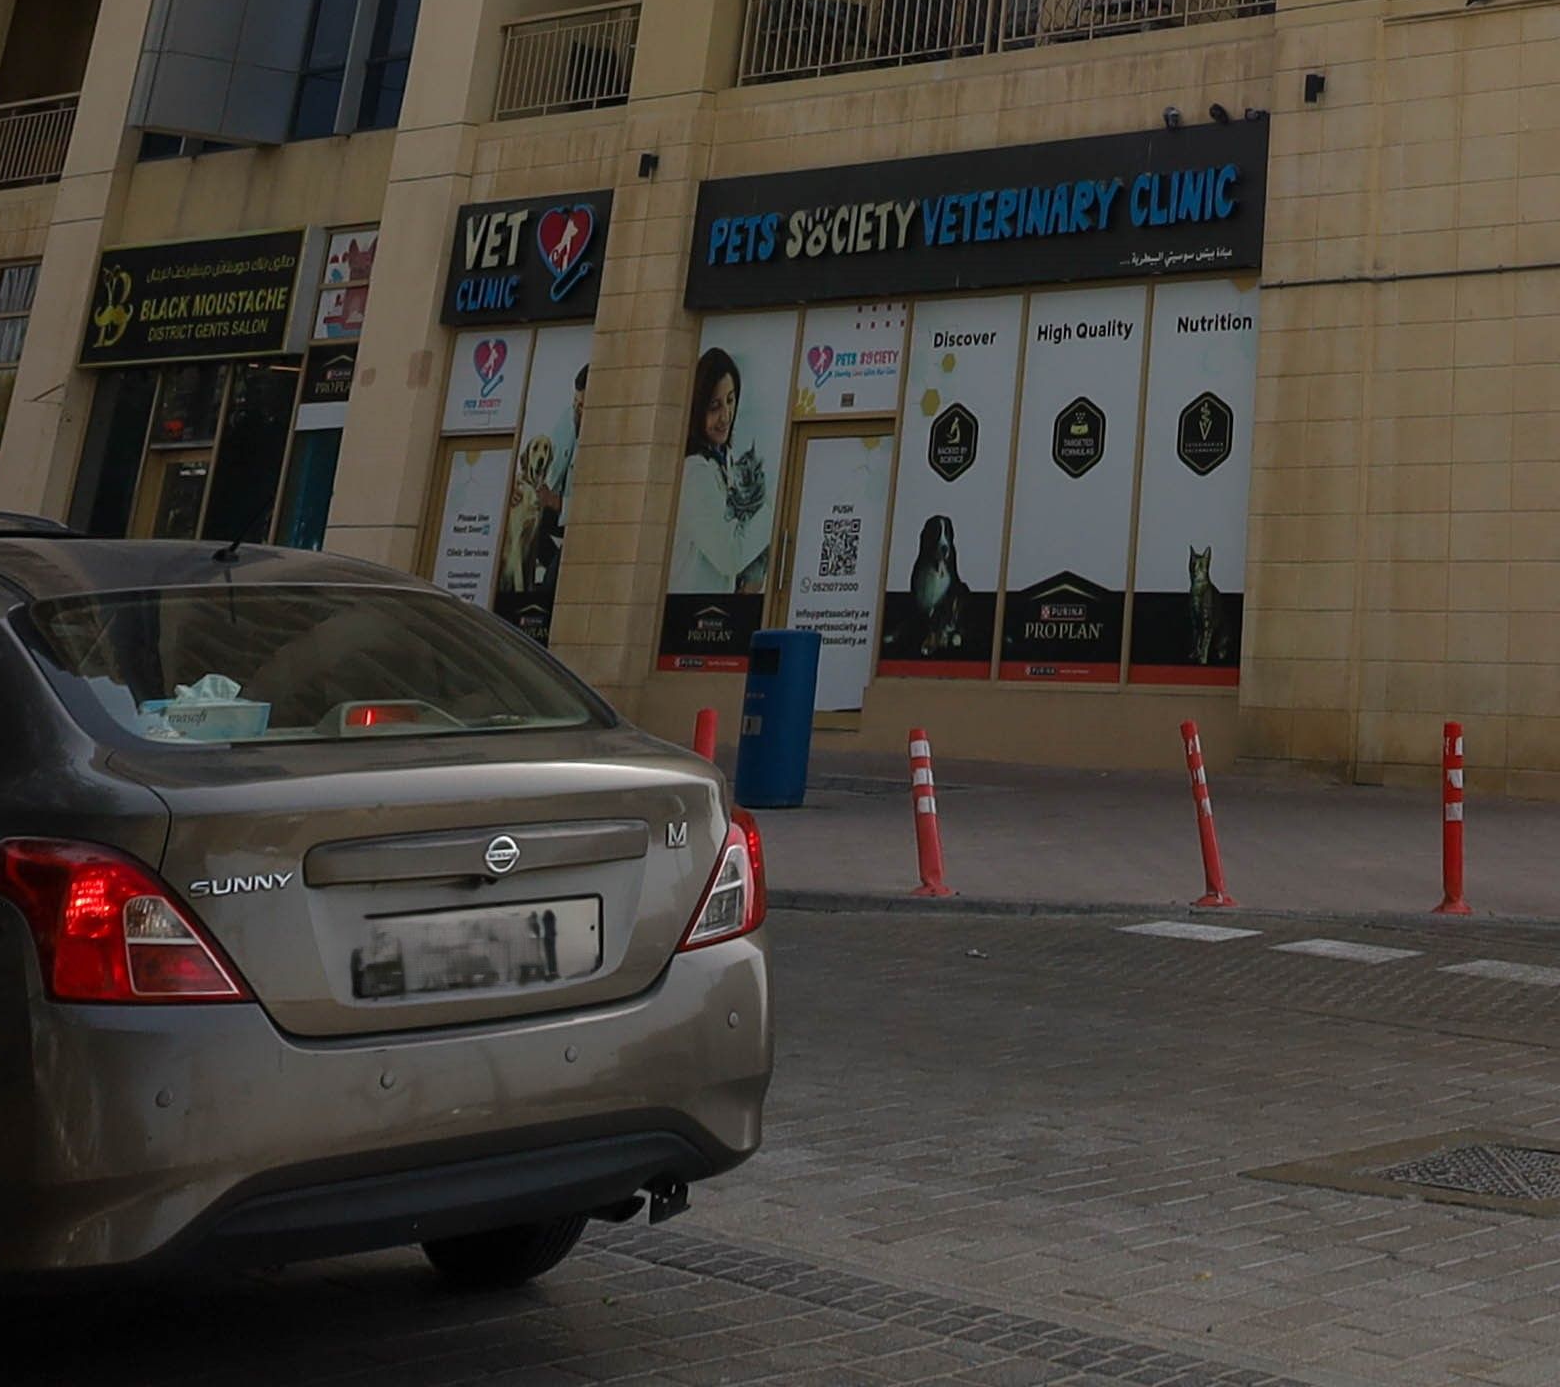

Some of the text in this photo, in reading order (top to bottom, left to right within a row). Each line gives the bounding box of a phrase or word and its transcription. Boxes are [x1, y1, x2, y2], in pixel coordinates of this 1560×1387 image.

[705, 163, 1239, 267] PETS SOCIETY VETERINARY CLINIC
[465, 209, 529, 271] VET
[139, 287, 289, 322] BLACK MOUSTACHE
[456, 274, 521, 313] CLINIC
[147, 317, 269, 342] DISTRICT GENTS SALON
[1037, 321, 1134, 344] High Quality
[1176, 313, 1253, 334] Nutrition
[933, 330, 998, 348] Discover
[667, 822, 688, 847] M
[189, 872, 294, 899] SUNNY
